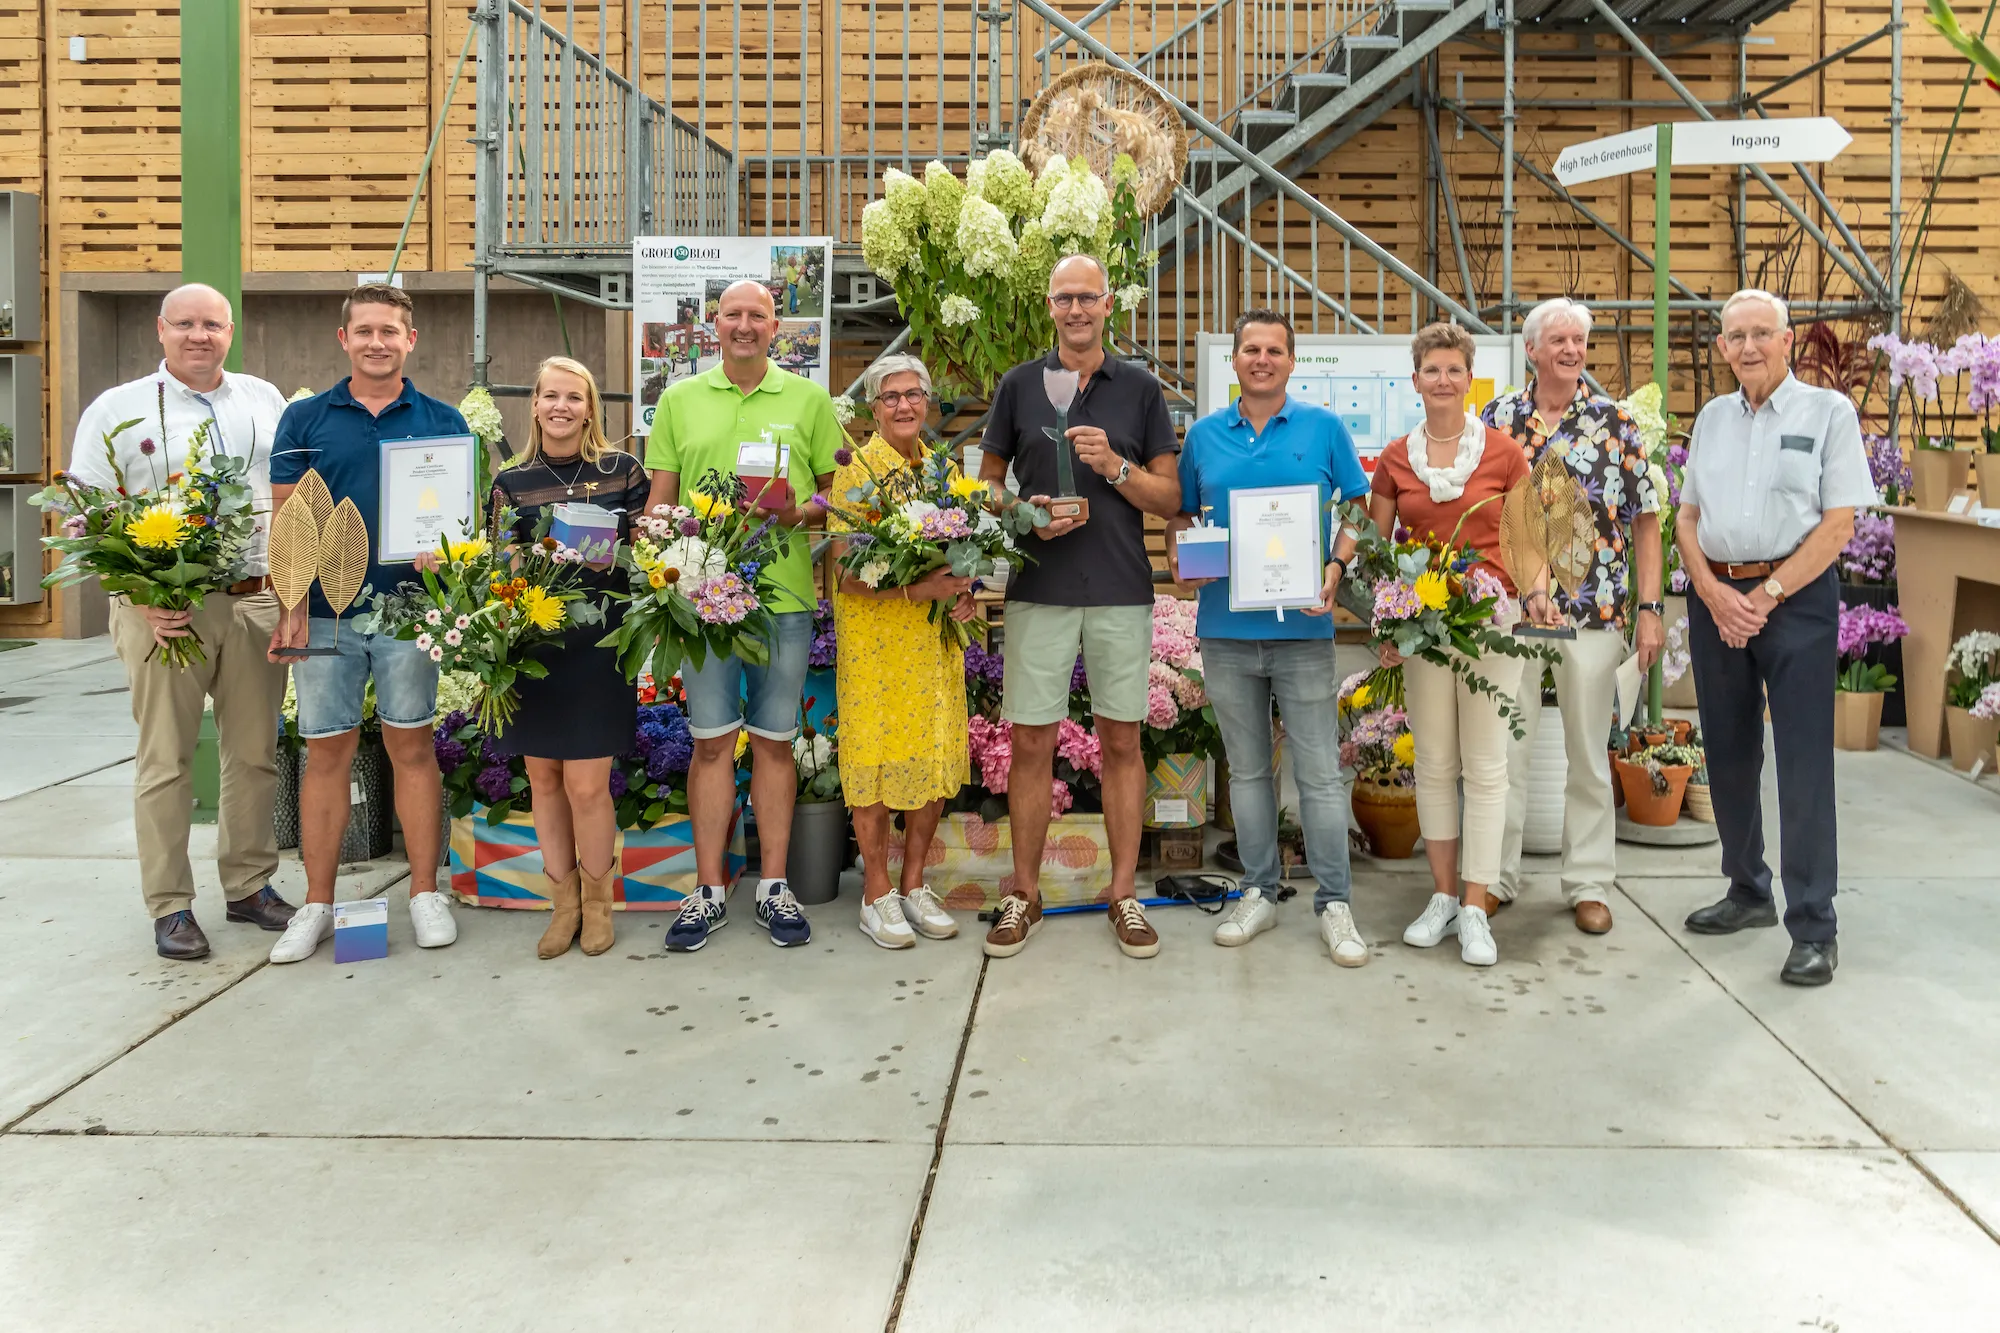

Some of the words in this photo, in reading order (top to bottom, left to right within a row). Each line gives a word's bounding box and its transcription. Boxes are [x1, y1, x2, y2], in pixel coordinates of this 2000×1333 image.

[1732, 134, 1780, 149] Ingang
[1560, 157, 1578, 173] High
[1580, 152, 1598, 167] Tech
[1600, 142, 1653, 163] Greenhouse
[641, 248, 673, 259] GROEI
[690, 248, 720, 259] BLOEI
[1315, 356, 1339, 364] map
